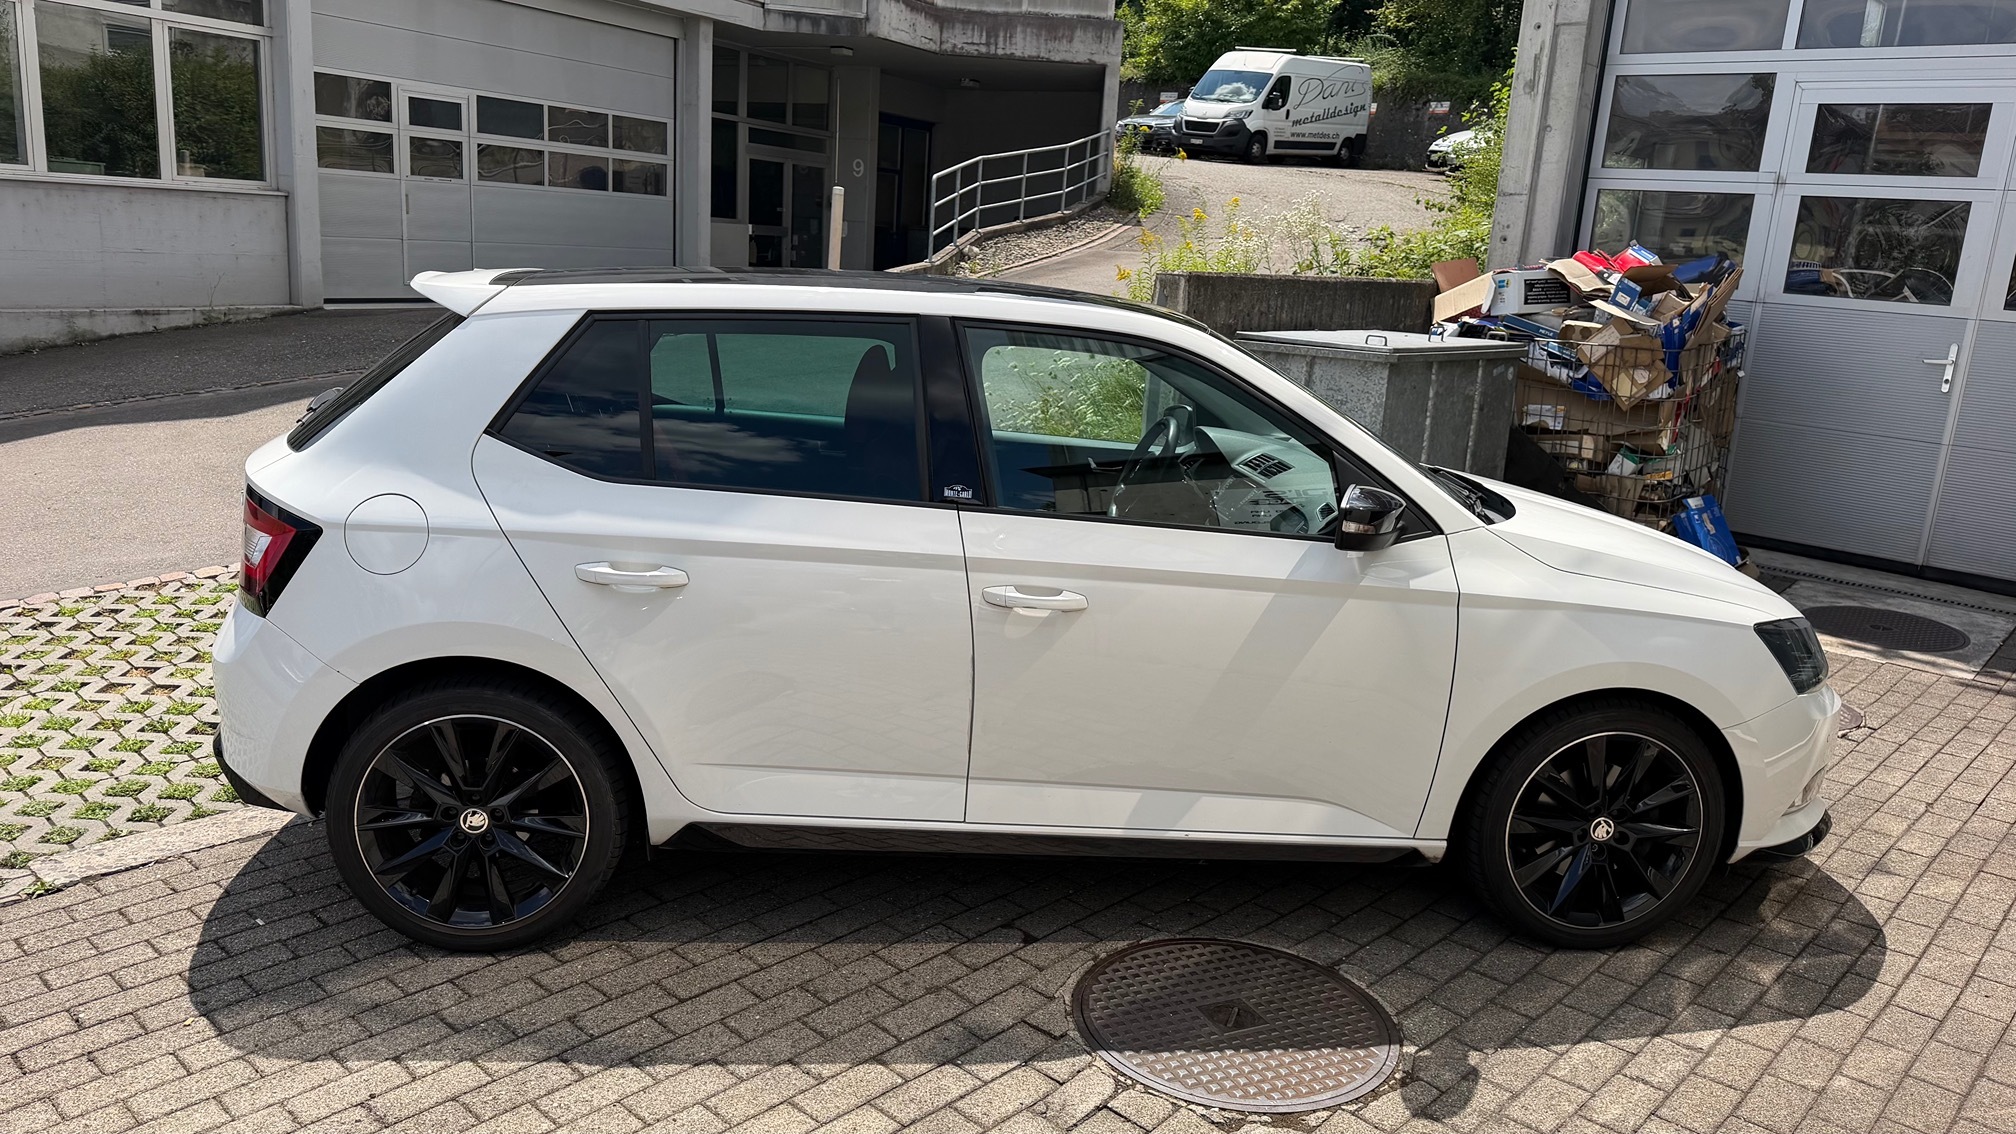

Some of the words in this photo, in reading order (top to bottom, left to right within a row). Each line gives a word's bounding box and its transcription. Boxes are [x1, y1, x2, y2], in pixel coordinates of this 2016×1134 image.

[1292, 102, 1366, 127] metalldesign
[1290, 131, 1340, 140] www.metdes.ch
[852, 158, 864, 177] 9
